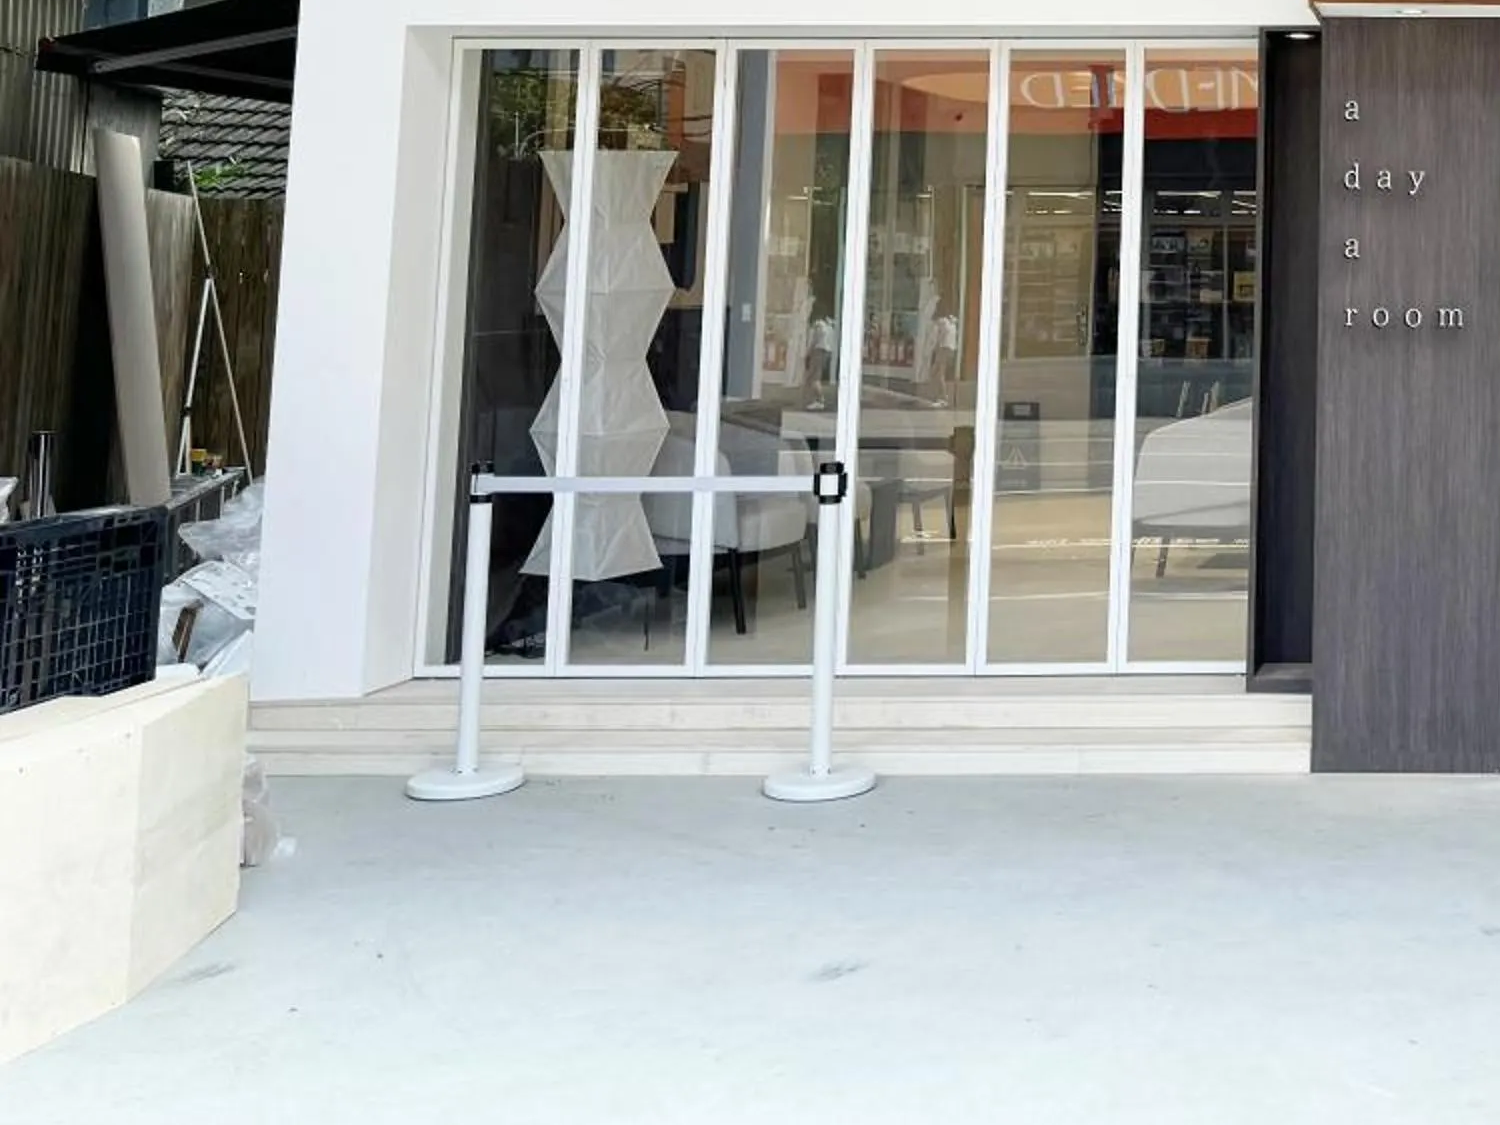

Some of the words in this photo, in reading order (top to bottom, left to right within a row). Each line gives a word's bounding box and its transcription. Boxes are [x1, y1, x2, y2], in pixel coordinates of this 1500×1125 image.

[1344, 98, 1361, 121] a
[1344, 164, 1426, 195] day
[1344, 236, 1361, 258] a
[1344, 304, 1466, 328] room
